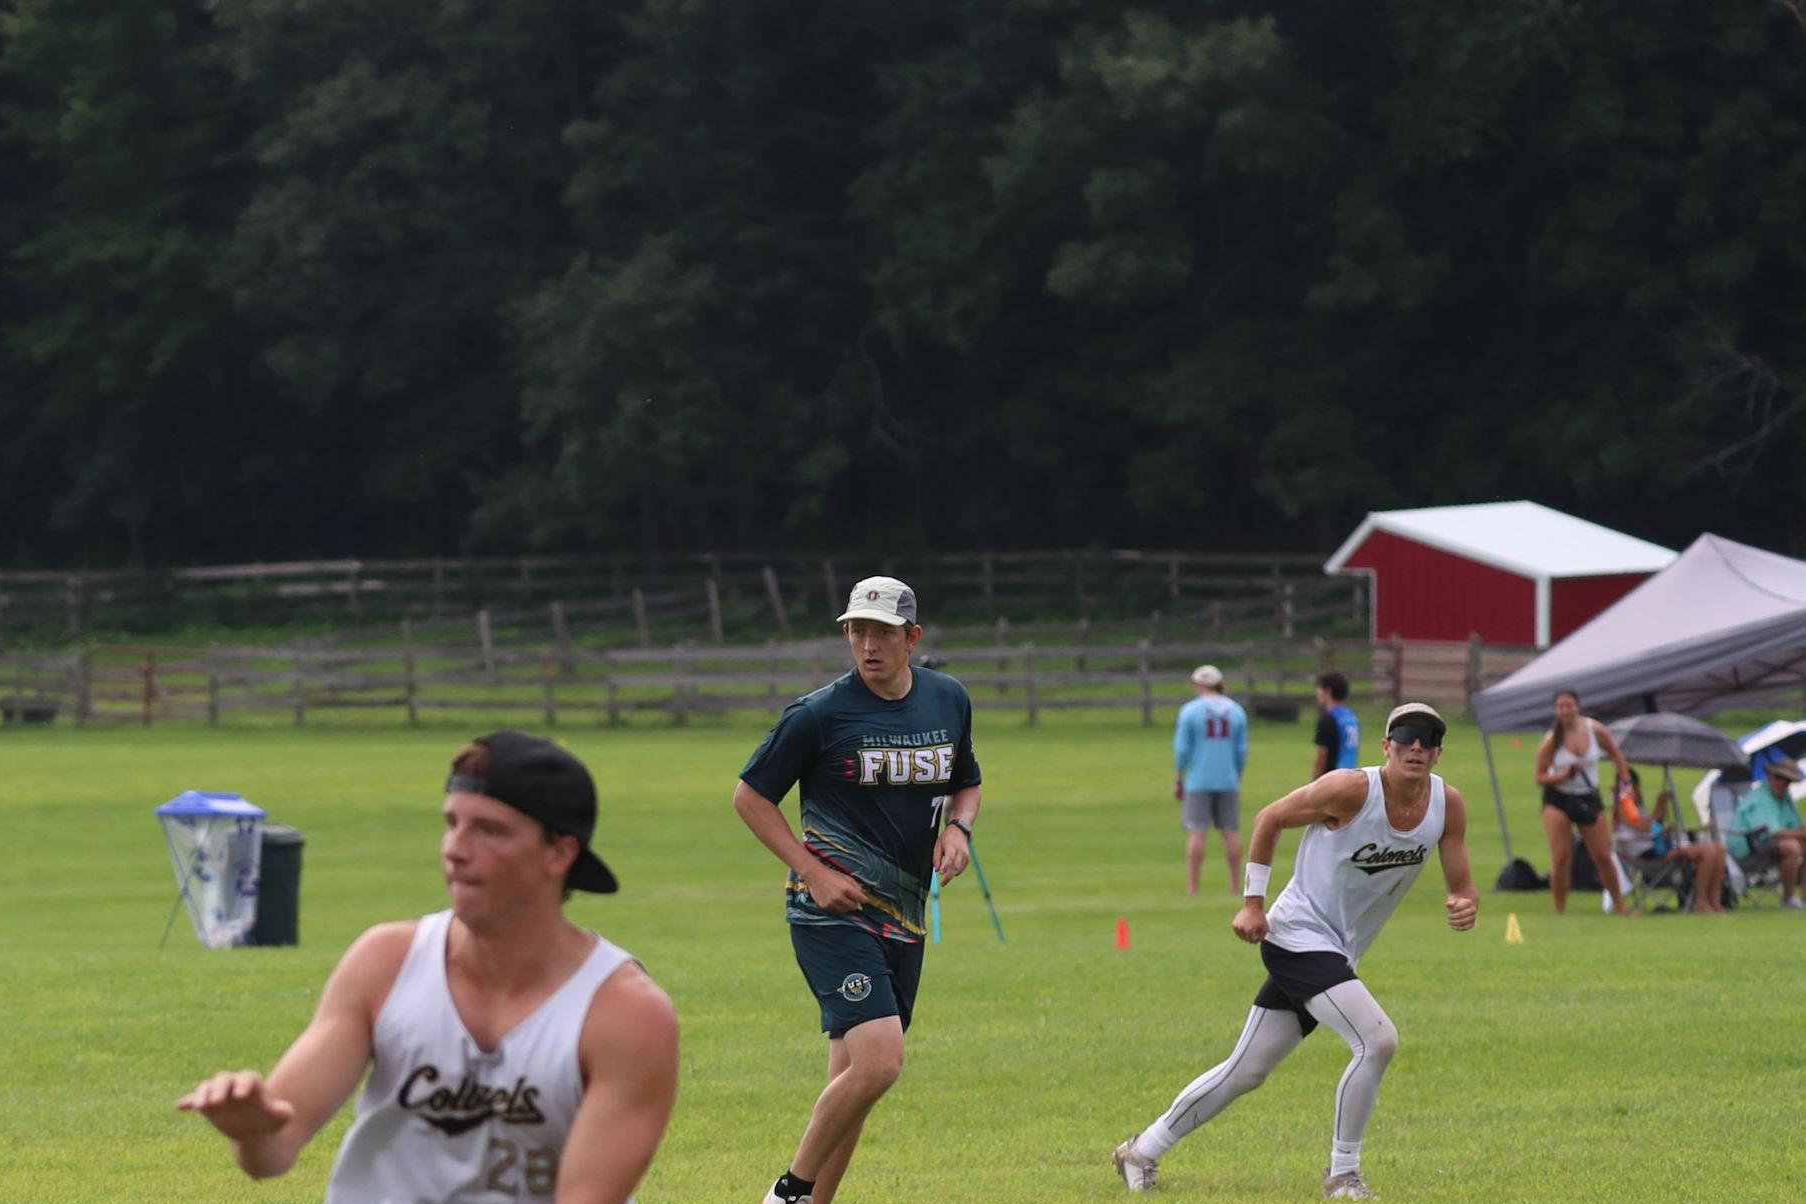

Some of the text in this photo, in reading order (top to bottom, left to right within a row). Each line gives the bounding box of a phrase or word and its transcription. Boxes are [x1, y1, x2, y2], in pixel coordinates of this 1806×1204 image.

[863, 729, 948, 747] MILWAUKEE
[858, 744, 954, 785] FUSE
[1351, 843, 1427, 866] Colonels
[488, 1136, 558, 1197] 28
